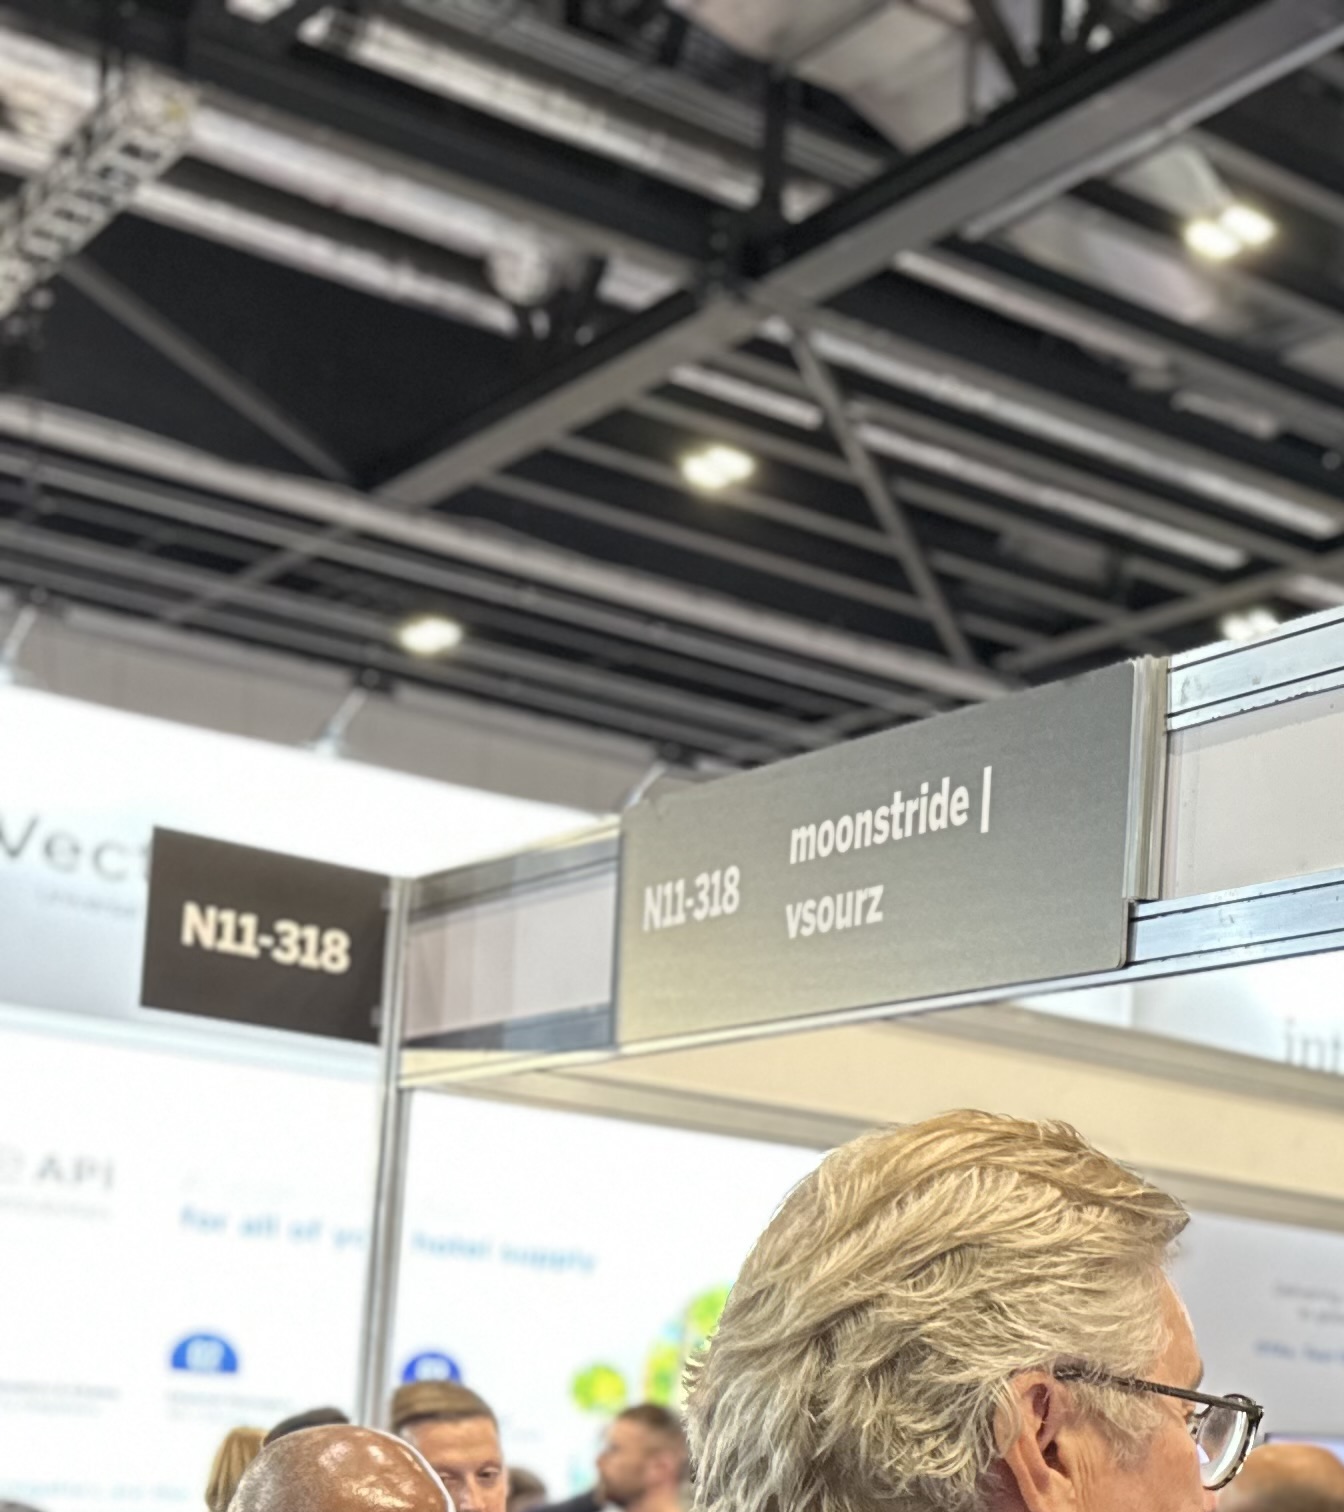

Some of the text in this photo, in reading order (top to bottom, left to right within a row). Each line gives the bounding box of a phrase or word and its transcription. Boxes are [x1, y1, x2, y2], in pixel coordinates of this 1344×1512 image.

[0, 814, 150, 884] Vec
[789, 776, 970, 864] moonstride
[642, 865, 741, 932] N11-318
[785, 883, 885, 939] vsourz
[181, 899, 351, 975] N11-318
